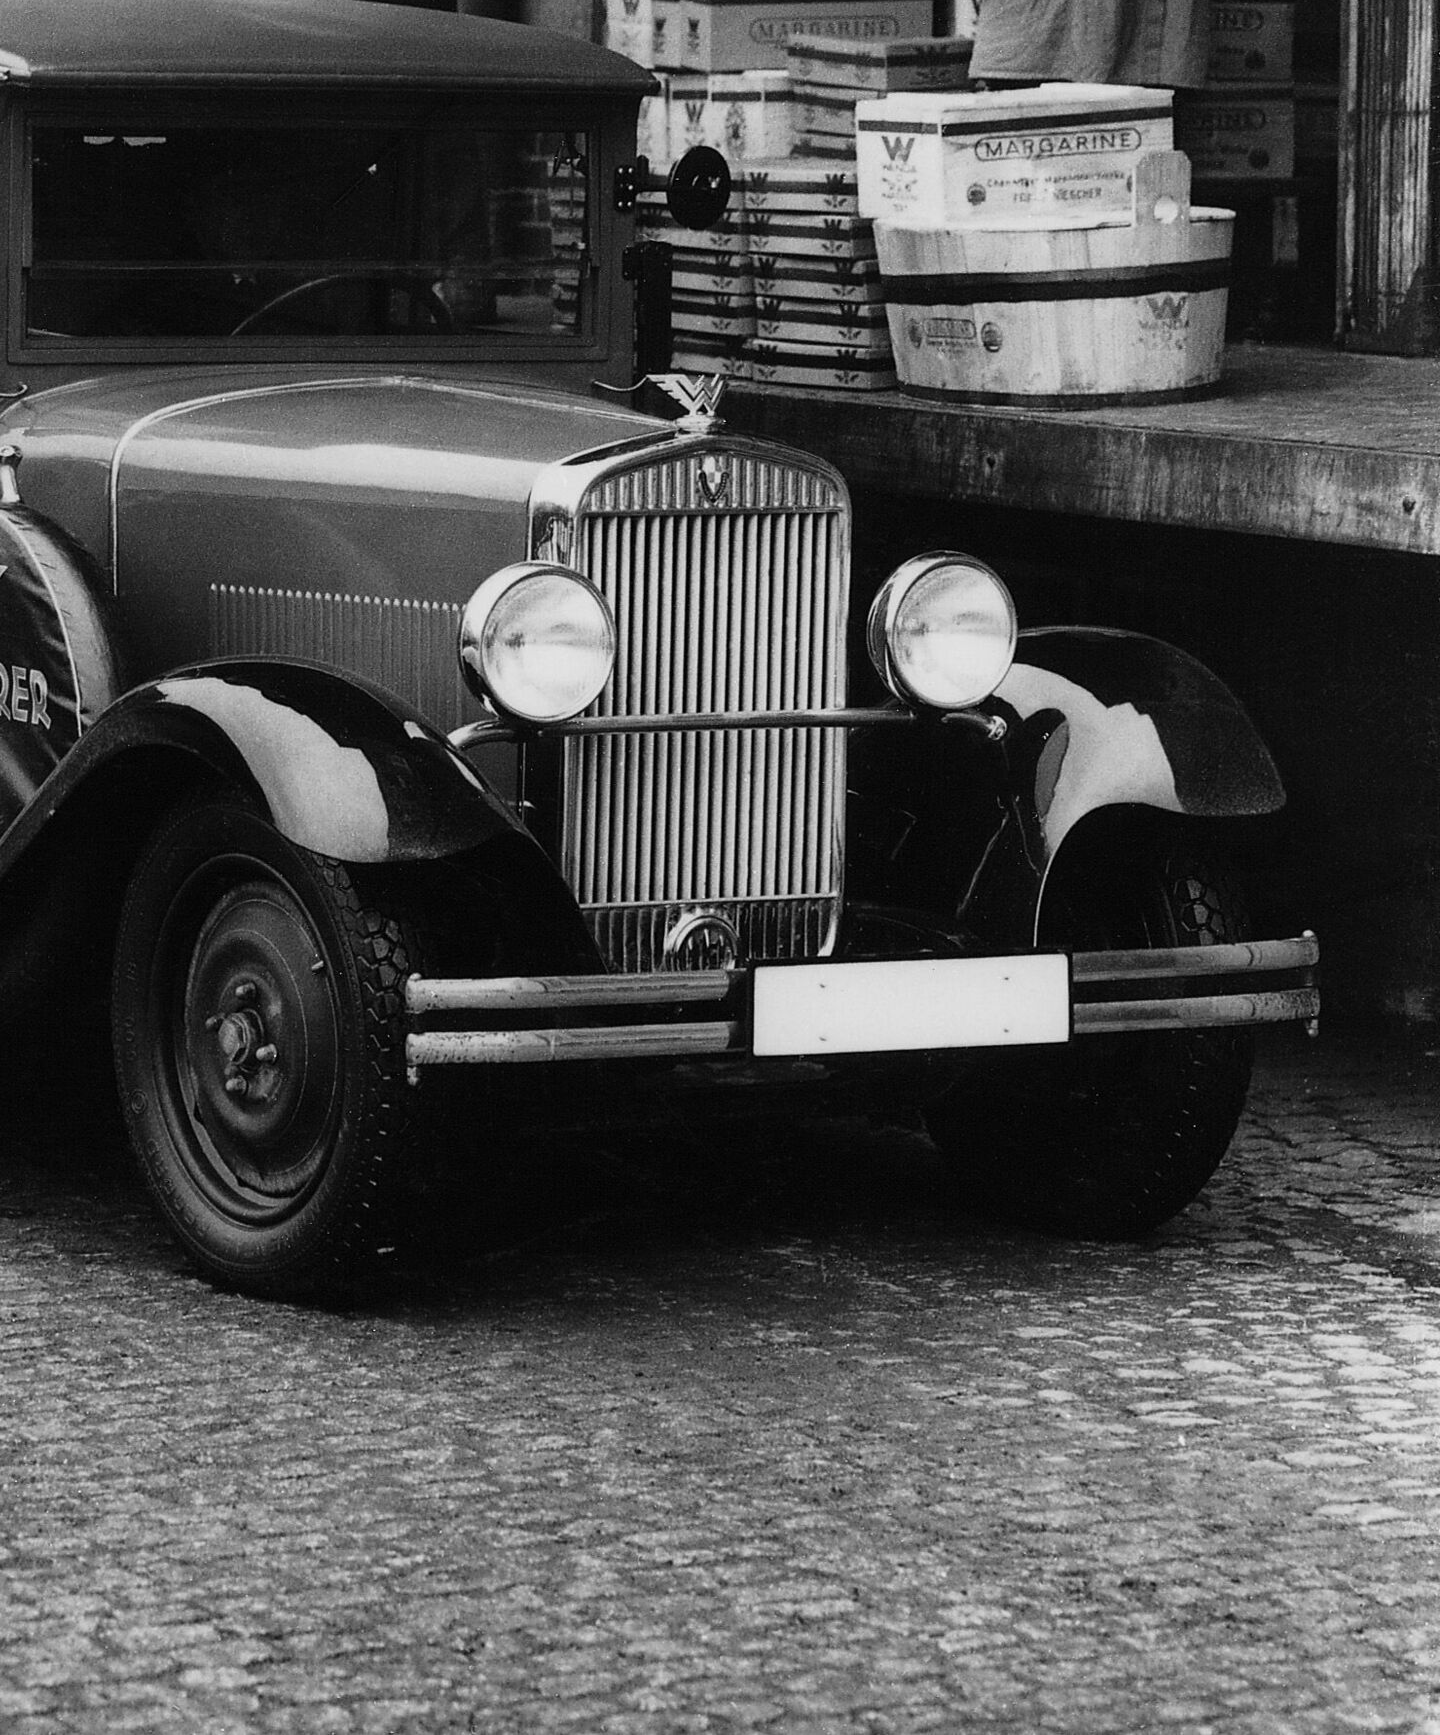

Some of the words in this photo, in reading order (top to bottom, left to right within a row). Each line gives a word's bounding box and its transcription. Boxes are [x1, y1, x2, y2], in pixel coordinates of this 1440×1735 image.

[881, 135, 916, 163] W
[985, 132, 1132, 157] MARGARINE
[1145, 294, 1187, 321] W
